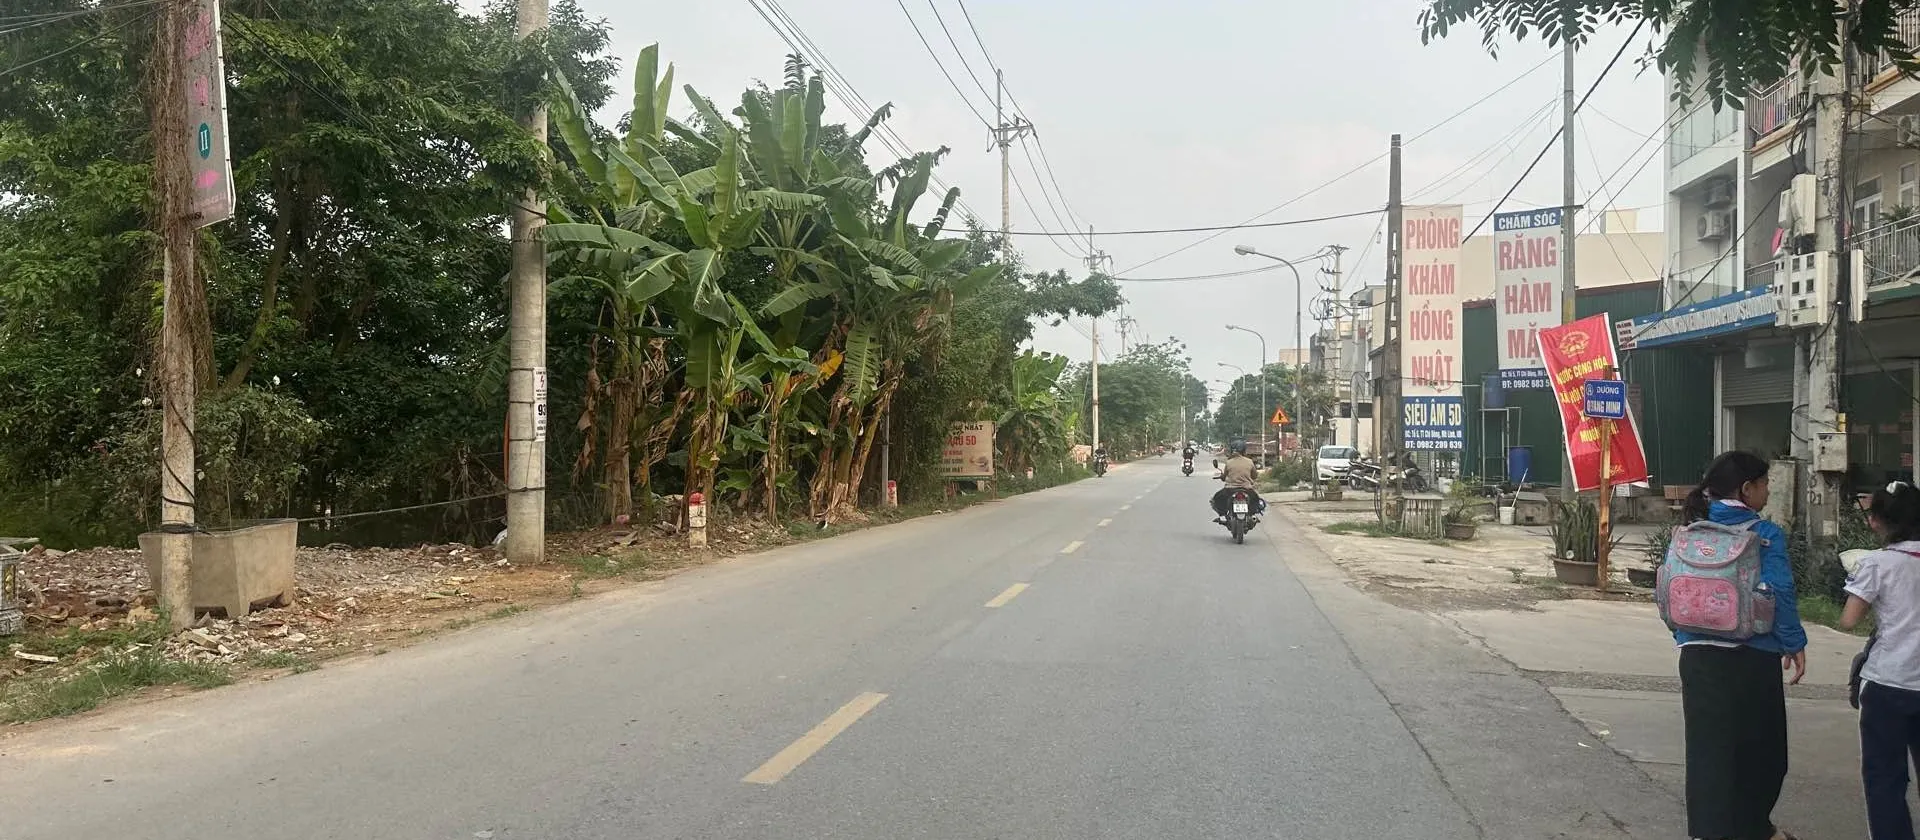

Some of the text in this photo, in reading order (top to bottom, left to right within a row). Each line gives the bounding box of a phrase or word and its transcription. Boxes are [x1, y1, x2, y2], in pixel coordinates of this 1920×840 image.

[1406, 211, 1459, 250] PHÒNG
[1498, 211, 1556, 230] CHĂM SÓC
[1499, 232, 1557, 271] RĂNG
[1408, 258, 1455, 295] KHÁM
[1504, 277, 1552, 314] HÀM
[1410, 299, 1453, 341] HỒNG
[1507, 321, 1541, 365] MẶ
[1404, 398, 1462, 426] SIÊU ÂM 5D
